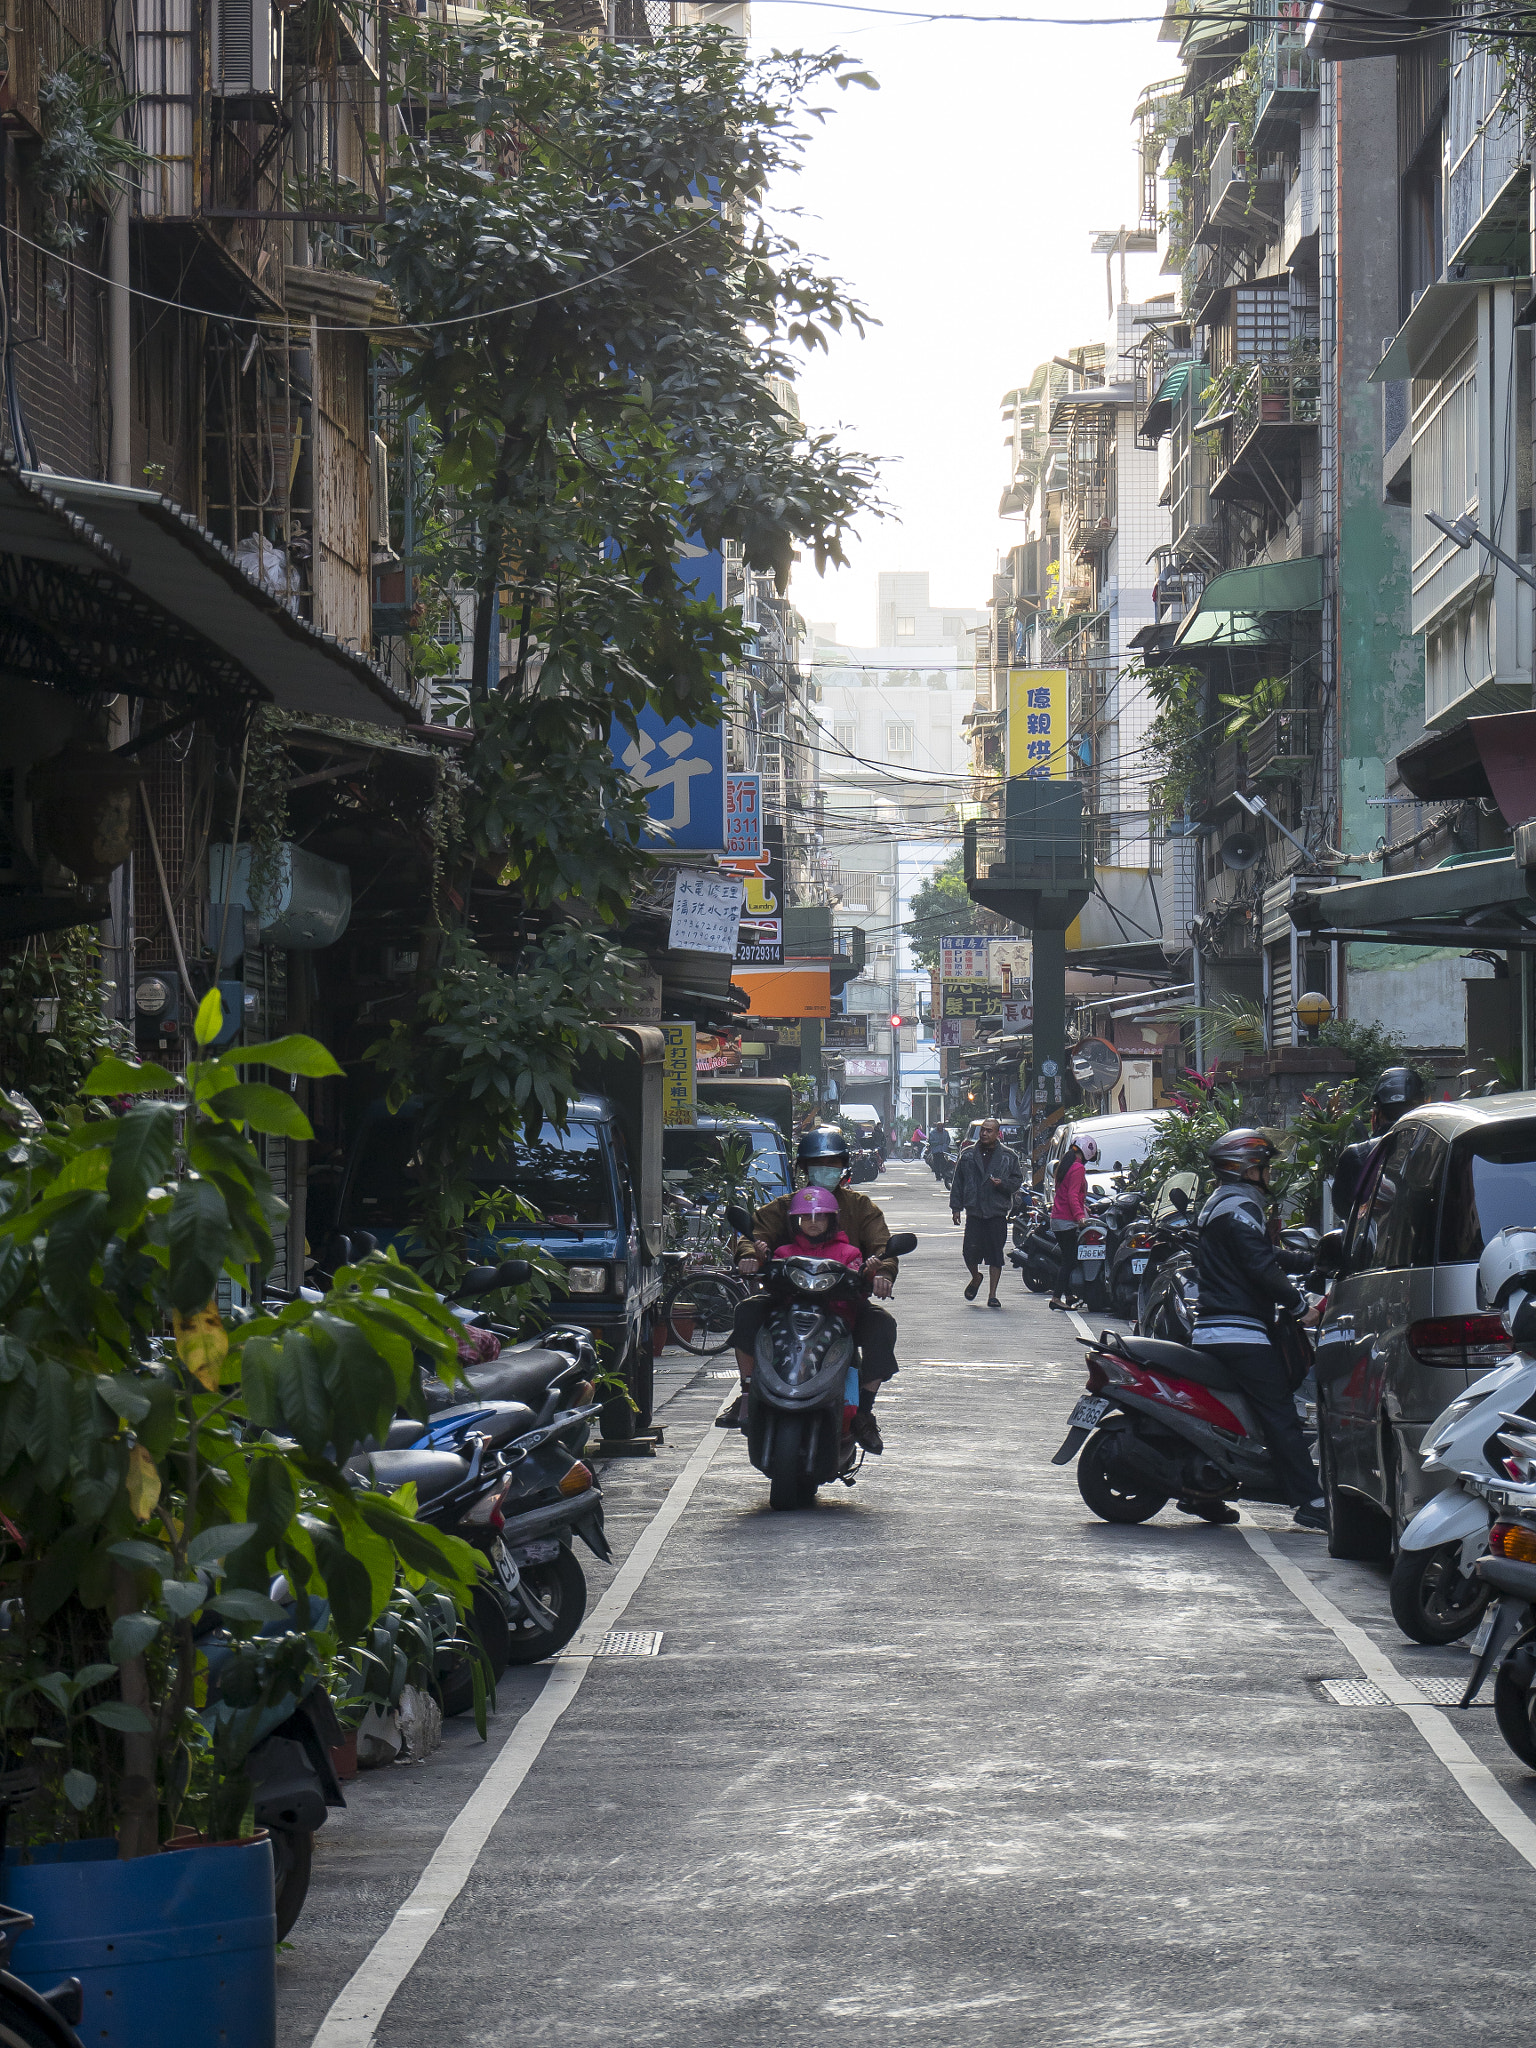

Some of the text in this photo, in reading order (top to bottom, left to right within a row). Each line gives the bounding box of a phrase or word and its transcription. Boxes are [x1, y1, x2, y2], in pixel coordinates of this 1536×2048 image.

[679, 880, 739, 899] 水電修理
[676, 899, 739, 921] 清洗水塔
[945, 997, 1003, 1016] 髮工坊
